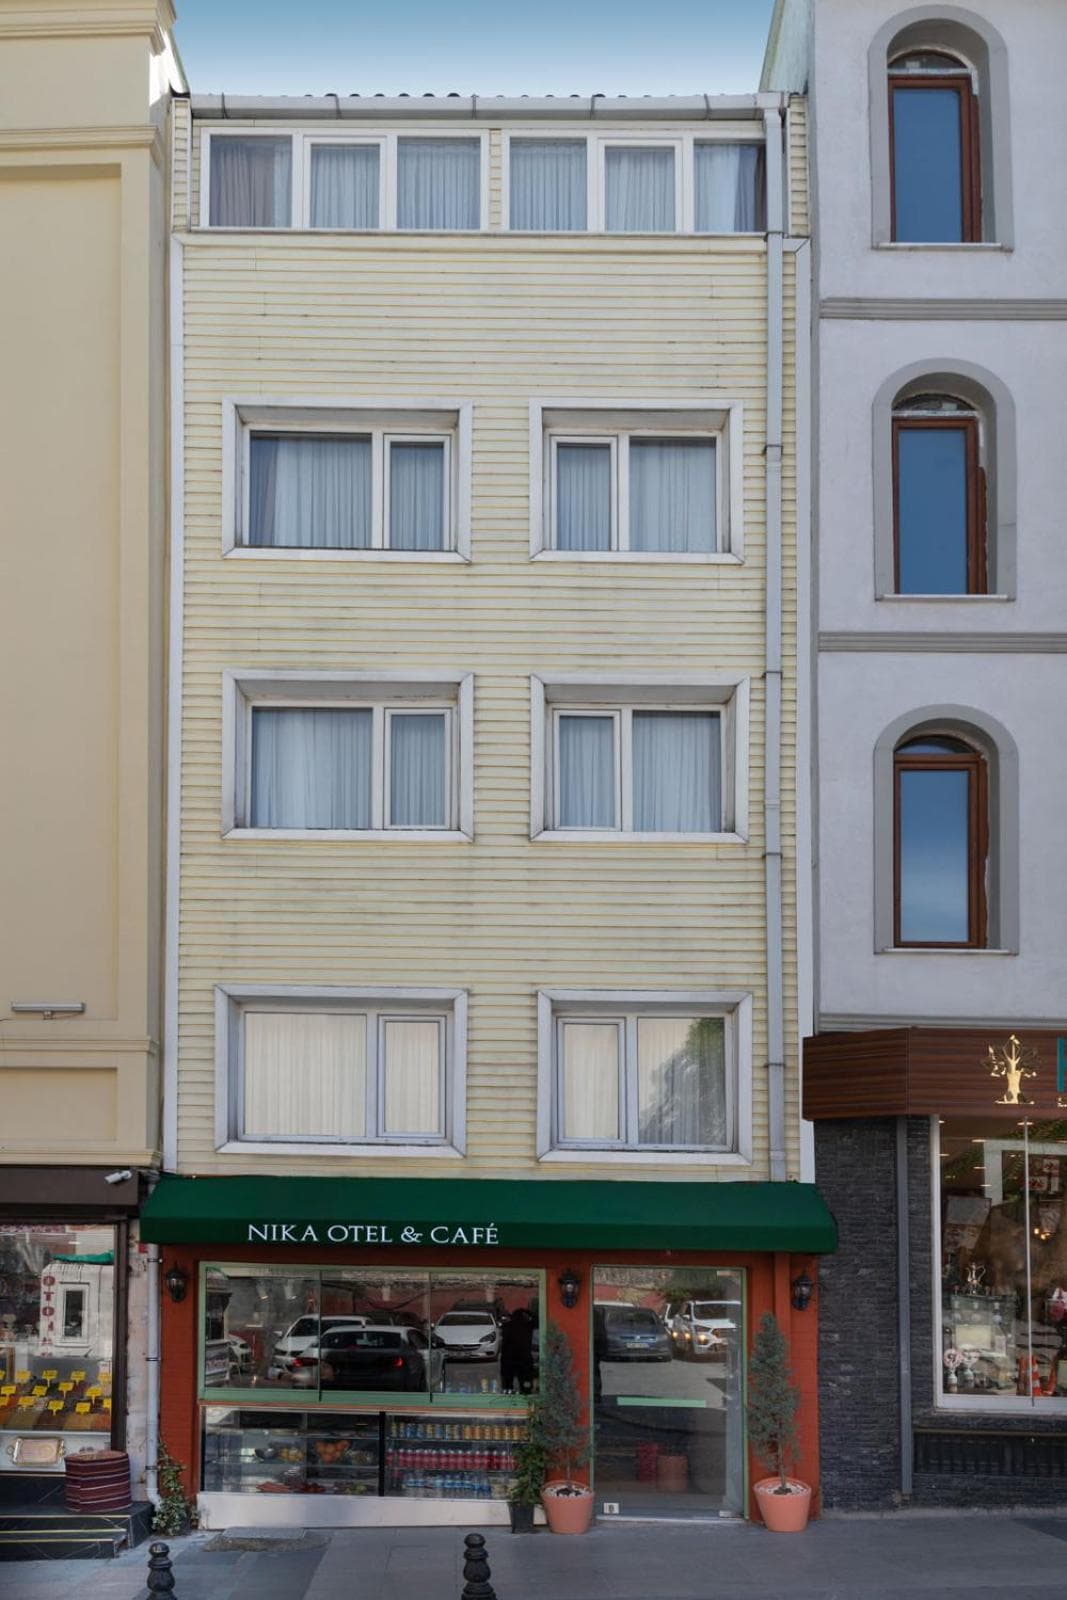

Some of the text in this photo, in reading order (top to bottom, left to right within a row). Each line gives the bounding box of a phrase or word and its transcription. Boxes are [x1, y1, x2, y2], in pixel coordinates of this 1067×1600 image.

[247, 1222, 500, 1245] NIKA OTEL & CAFÉ
